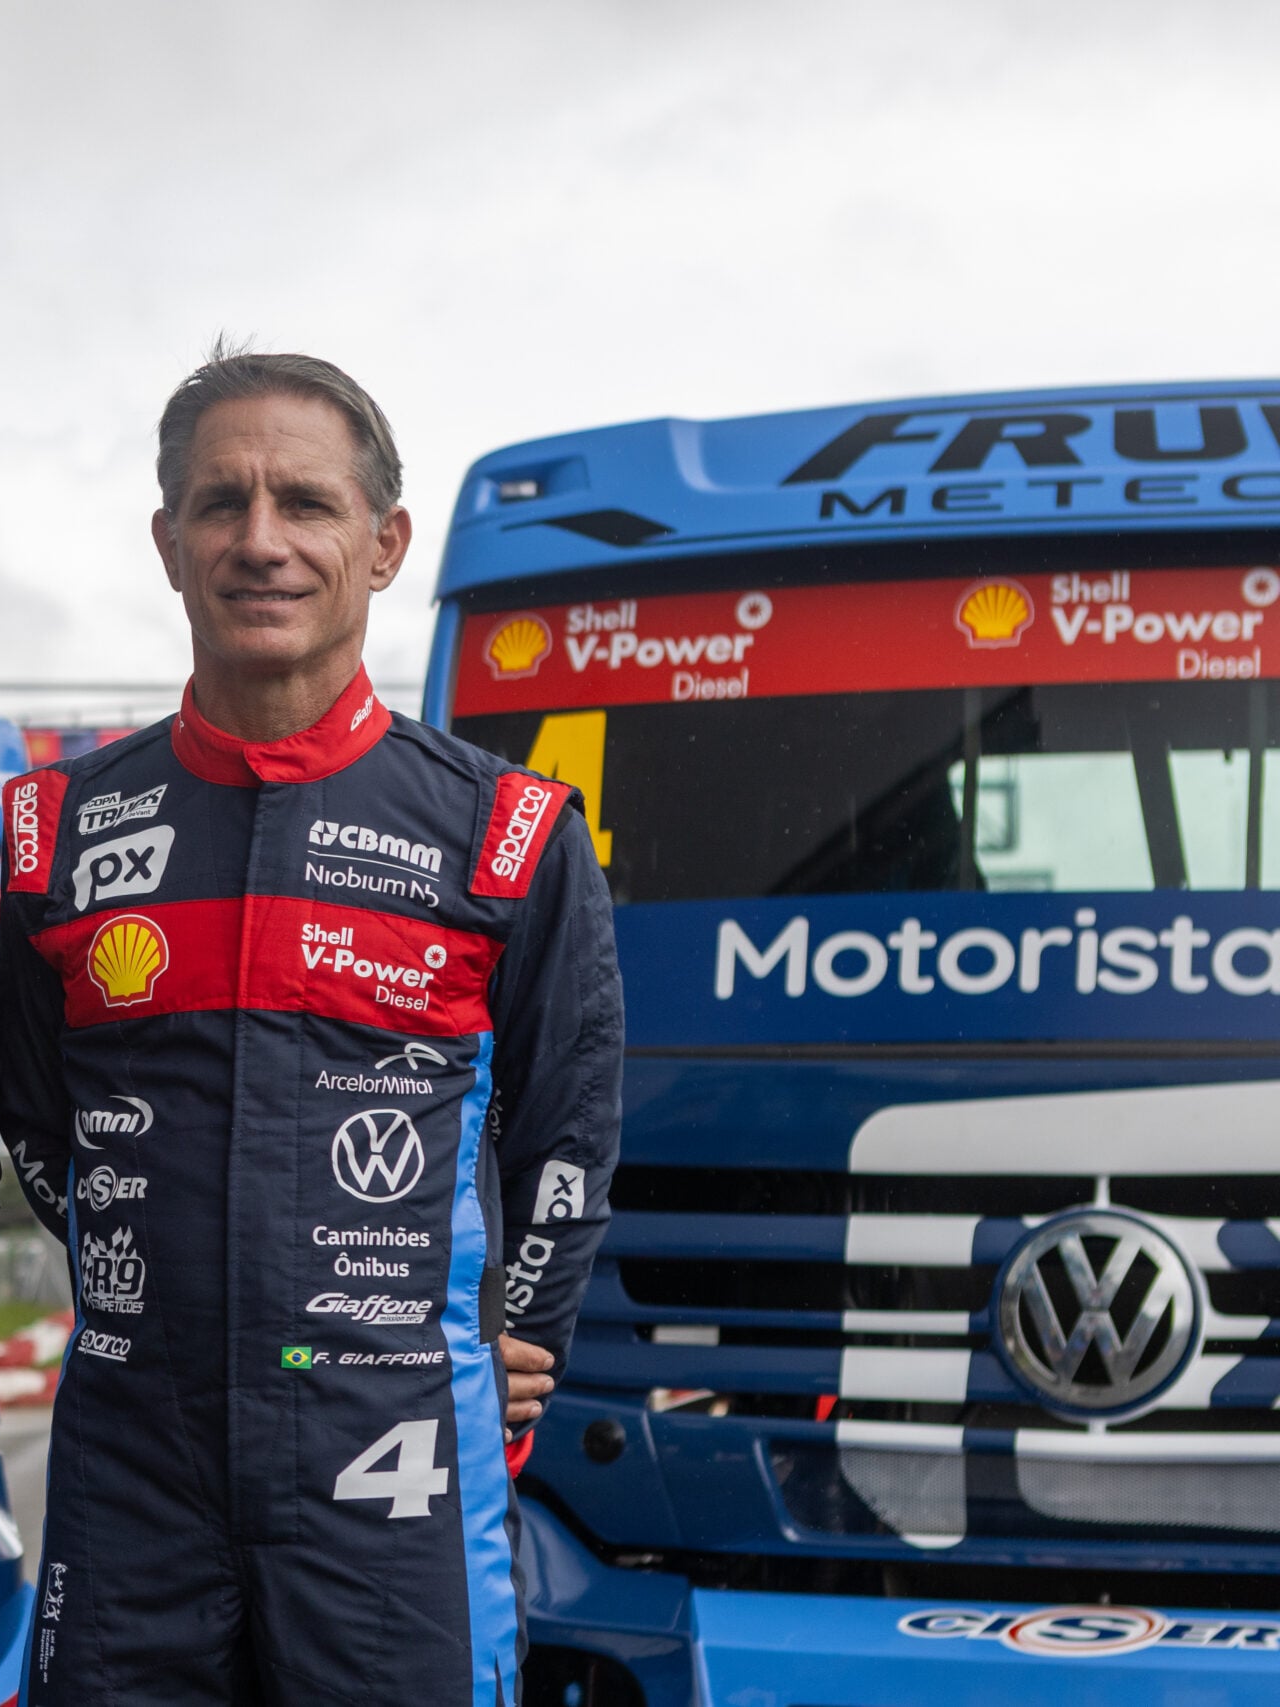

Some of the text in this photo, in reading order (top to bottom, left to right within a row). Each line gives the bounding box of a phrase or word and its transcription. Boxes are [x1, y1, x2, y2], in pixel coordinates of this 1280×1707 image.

[778, 394, 1280, 487] FRU
[819, 472, 1280, 520] METEO
[1051, 570, 1130, 604] Shell
[567, 599, 637, 634] Shell
[1051, 604, 1264, 645] V-Power
[566, 632, 754, 672] V-Power
[1178, 645, 1261, 679] Diesel
[673, 666, 749, 701] Diesel
[86, 794, 117, 808] COPA
[12, 782, 39, 873] sparco
[492, 786, 548, 881] sparco
[89, 845, 155, 901] px
[305, 861, 406, 897] Niobium
[301, 923, 354, 946] Shell
[301, 943, 434, 989] V-Power
[714, 908, 1280, 1000] Motorista
[375, 985, 429, 1011] Diesel
[315, 1070, 433, 1095] ArcelorMittal
[81, 1109, 140, 1134] omni
[77, 1170, 148, 1205] CISER
[313, 1226, 430, 1247] Caminhões
[334, 1252, 410, 1278] Ônibus
[306, 1292, 433, 1321] Giaffone
[80, 1328, 131, 1361] sparco
[313, 1351, 445, 1365] F. GIAFFONE
[333, 1418, 449, 1519] 4
[898, 1608, 1280, 1653] CISER
